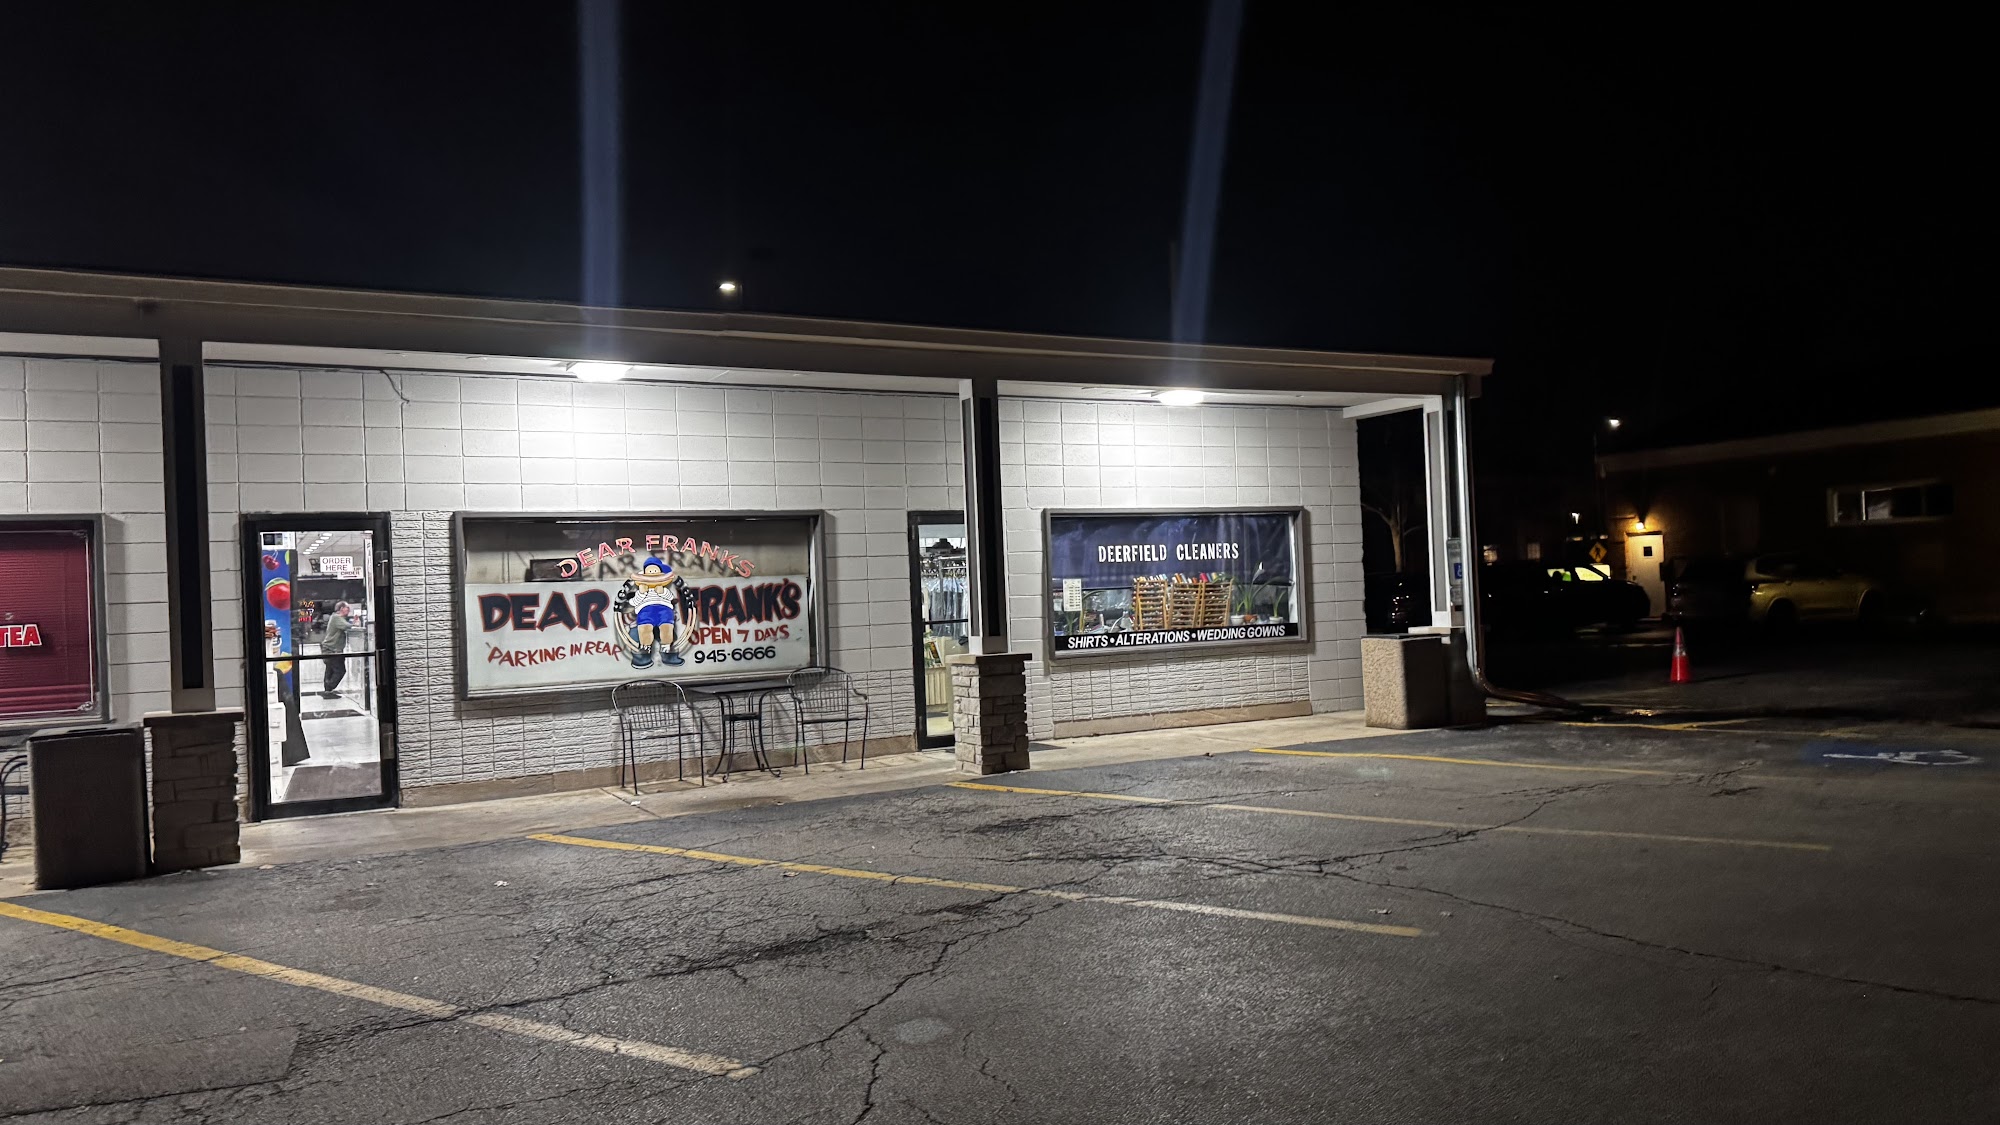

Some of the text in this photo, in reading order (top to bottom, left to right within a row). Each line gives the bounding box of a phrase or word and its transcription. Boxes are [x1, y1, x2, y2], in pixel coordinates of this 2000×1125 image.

[557, 534, 755, 578] DEAR FRANKS
[1098, 543, 1239, 562] DEERFIELD CLEANERS
[477, 588, 610, 632] DEAR
[688, 624, 790, 645] OPEN 7 DAYS
[1067, 625, 1286, 649] SHIRTS ALTERATIONS WEDDING GOWNS
[486, 640, 623, 667] PARKING IN REAR
